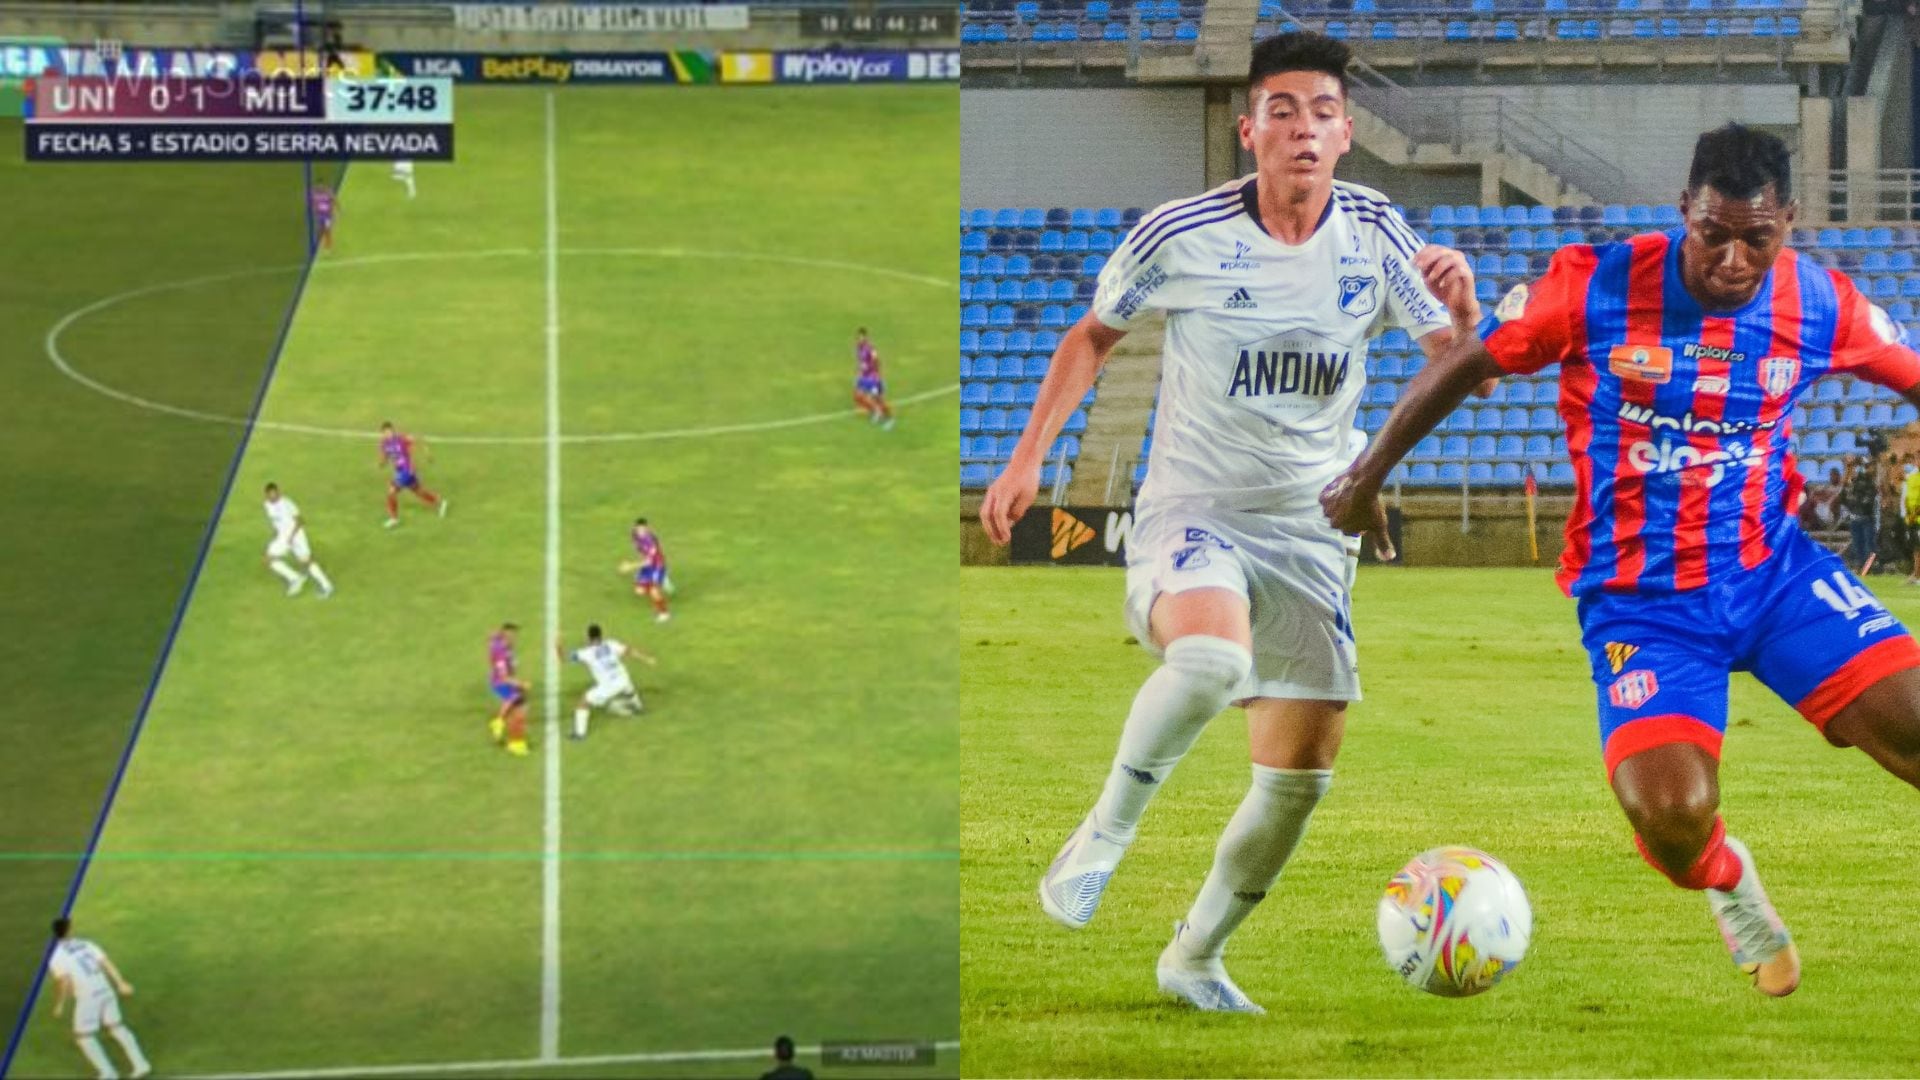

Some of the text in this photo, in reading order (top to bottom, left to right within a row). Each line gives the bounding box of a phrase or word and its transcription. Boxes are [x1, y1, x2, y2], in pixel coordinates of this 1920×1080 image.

[413, 57, 664, 81] LIGA BetPlay DIMAYOR
[1223, 299, 1258, 309] adidas
[1684, 343, 1745, 362] Wplay.co
[1228, 349, 1350, 397] ANDINA
